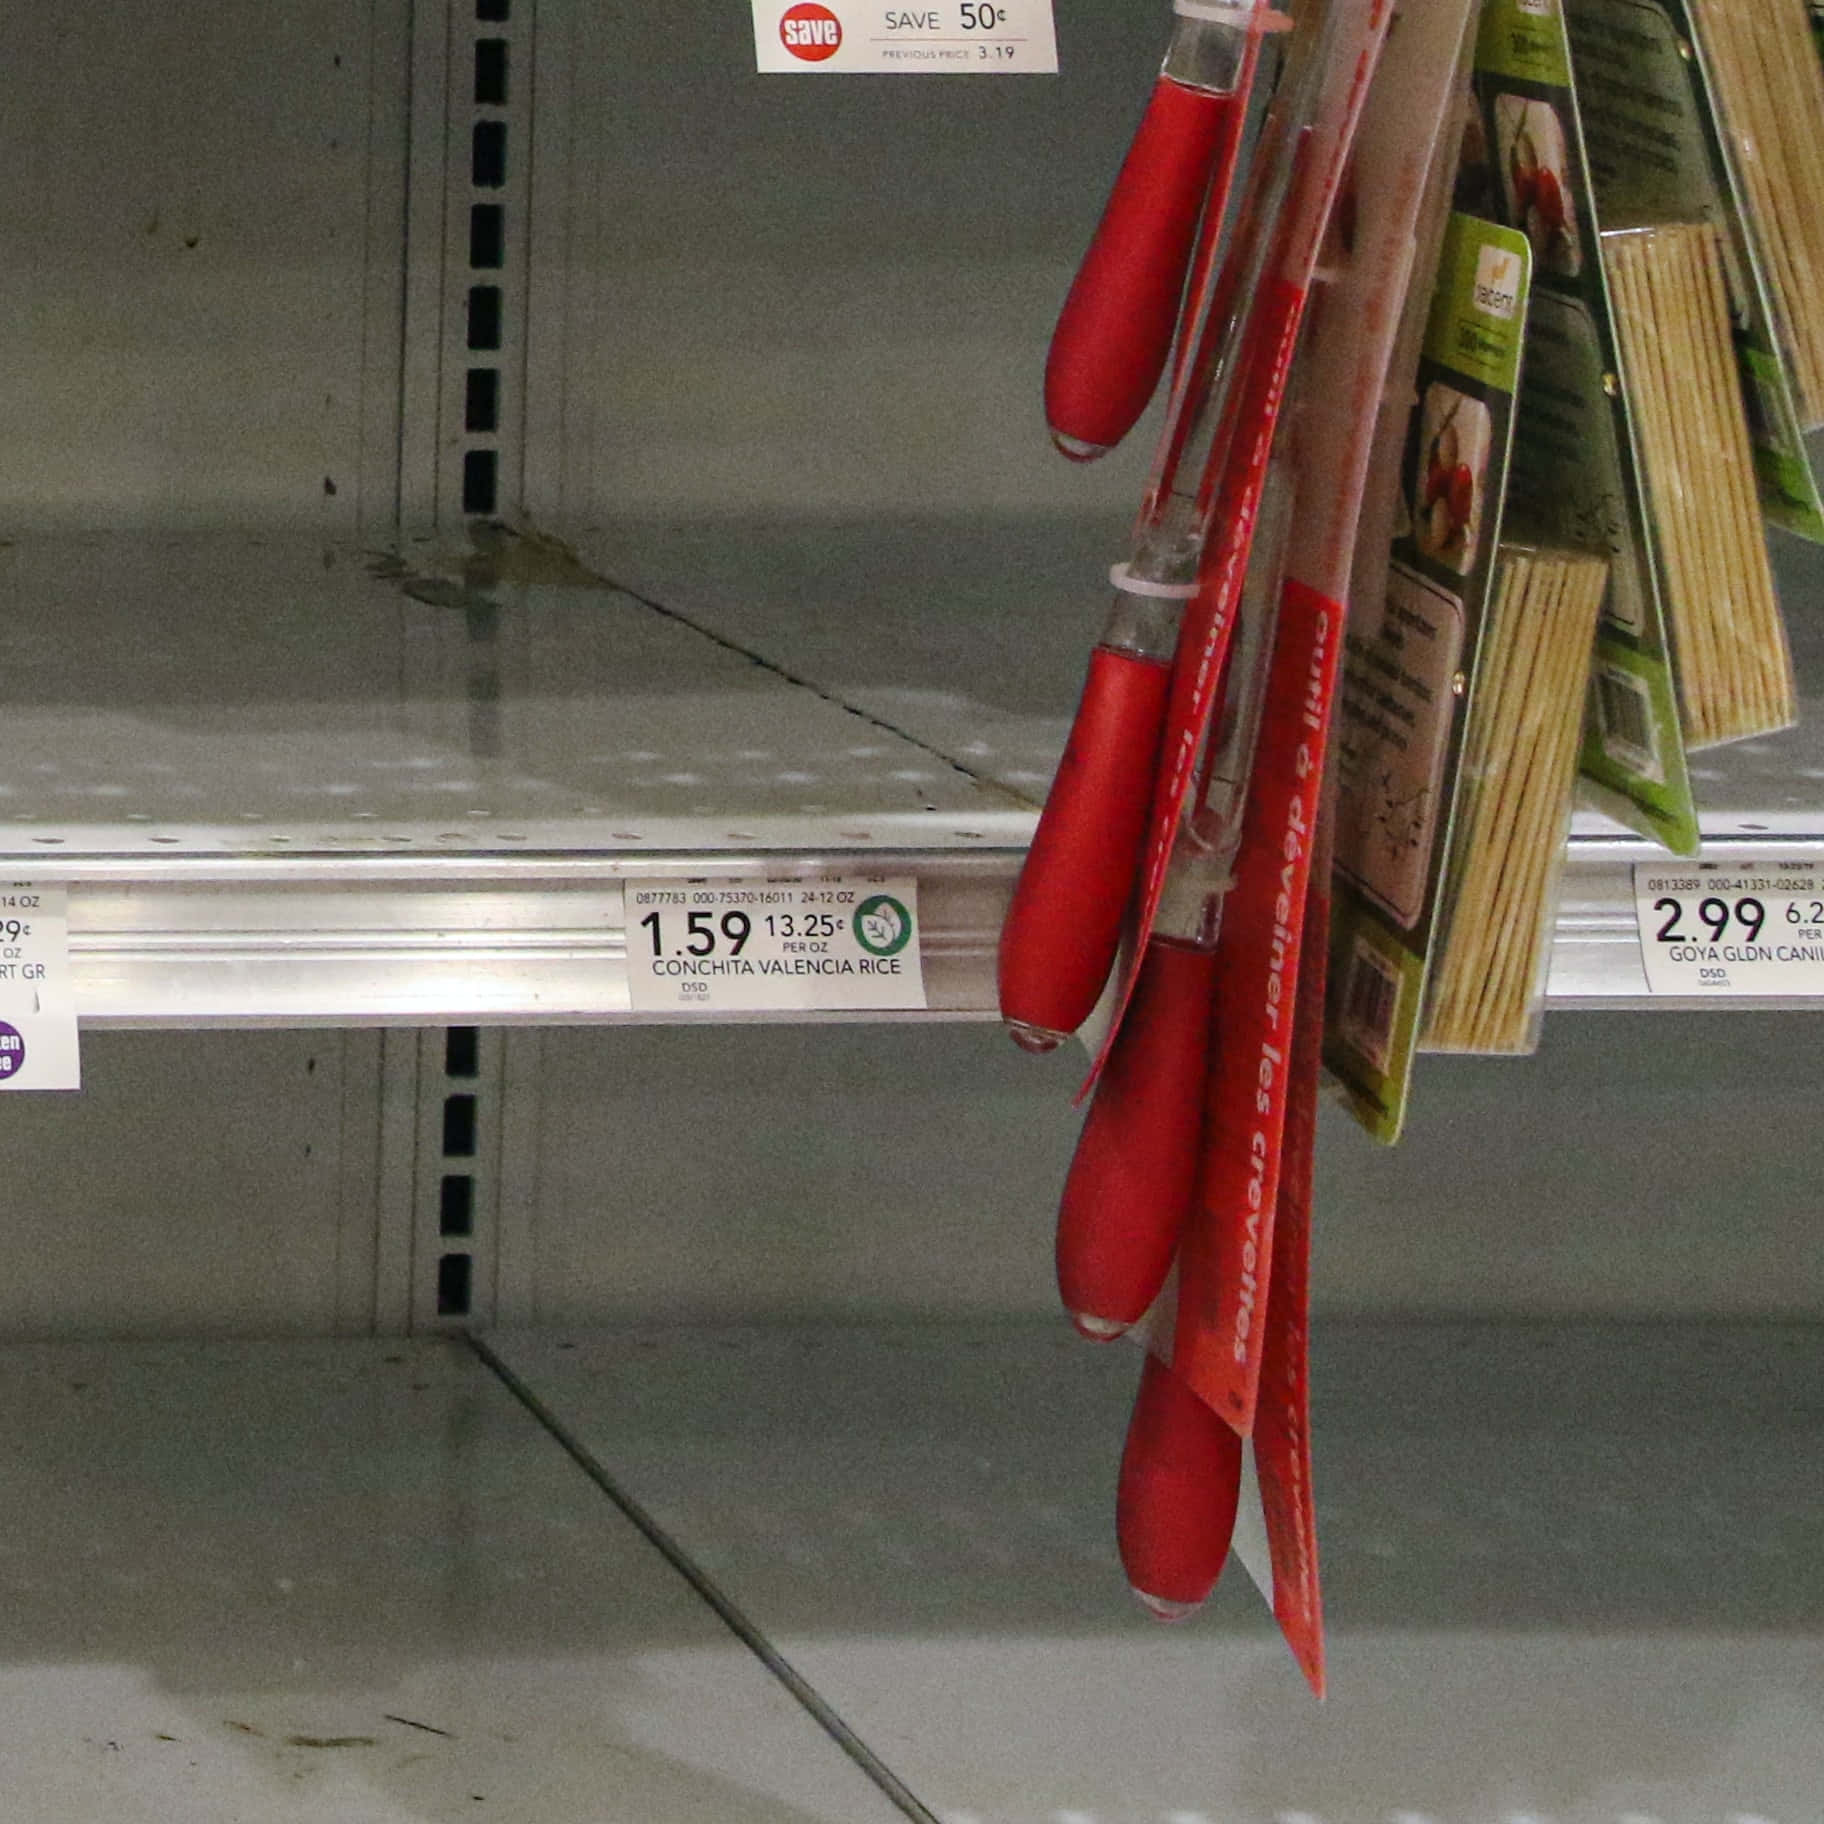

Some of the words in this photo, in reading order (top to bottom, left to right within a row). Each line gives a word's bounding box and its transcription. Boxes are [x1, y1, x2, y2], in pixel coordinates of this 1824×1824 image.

[885, 12, 940, 30] SAVE
[959, 3, 1007, 30] 50¢
[784, 23, 838, 46] save
[764, 915, 845, 938] 13.25¢
[1654, 897, 1765, 942] 2.99
[640, 911, 751, 957] 1.59
[1670, 946, 1718, 961] GOYA
[1724, 946, 1772, 961] GLDN
[1776, 946, 1824, 961] CANIL
[22, 964, 46, 979] GR
[652, 960, 754, 976] CONCHITA
[758, 959, 853, 975] VALENCIA
[860, 959, 901, 975] RICE
